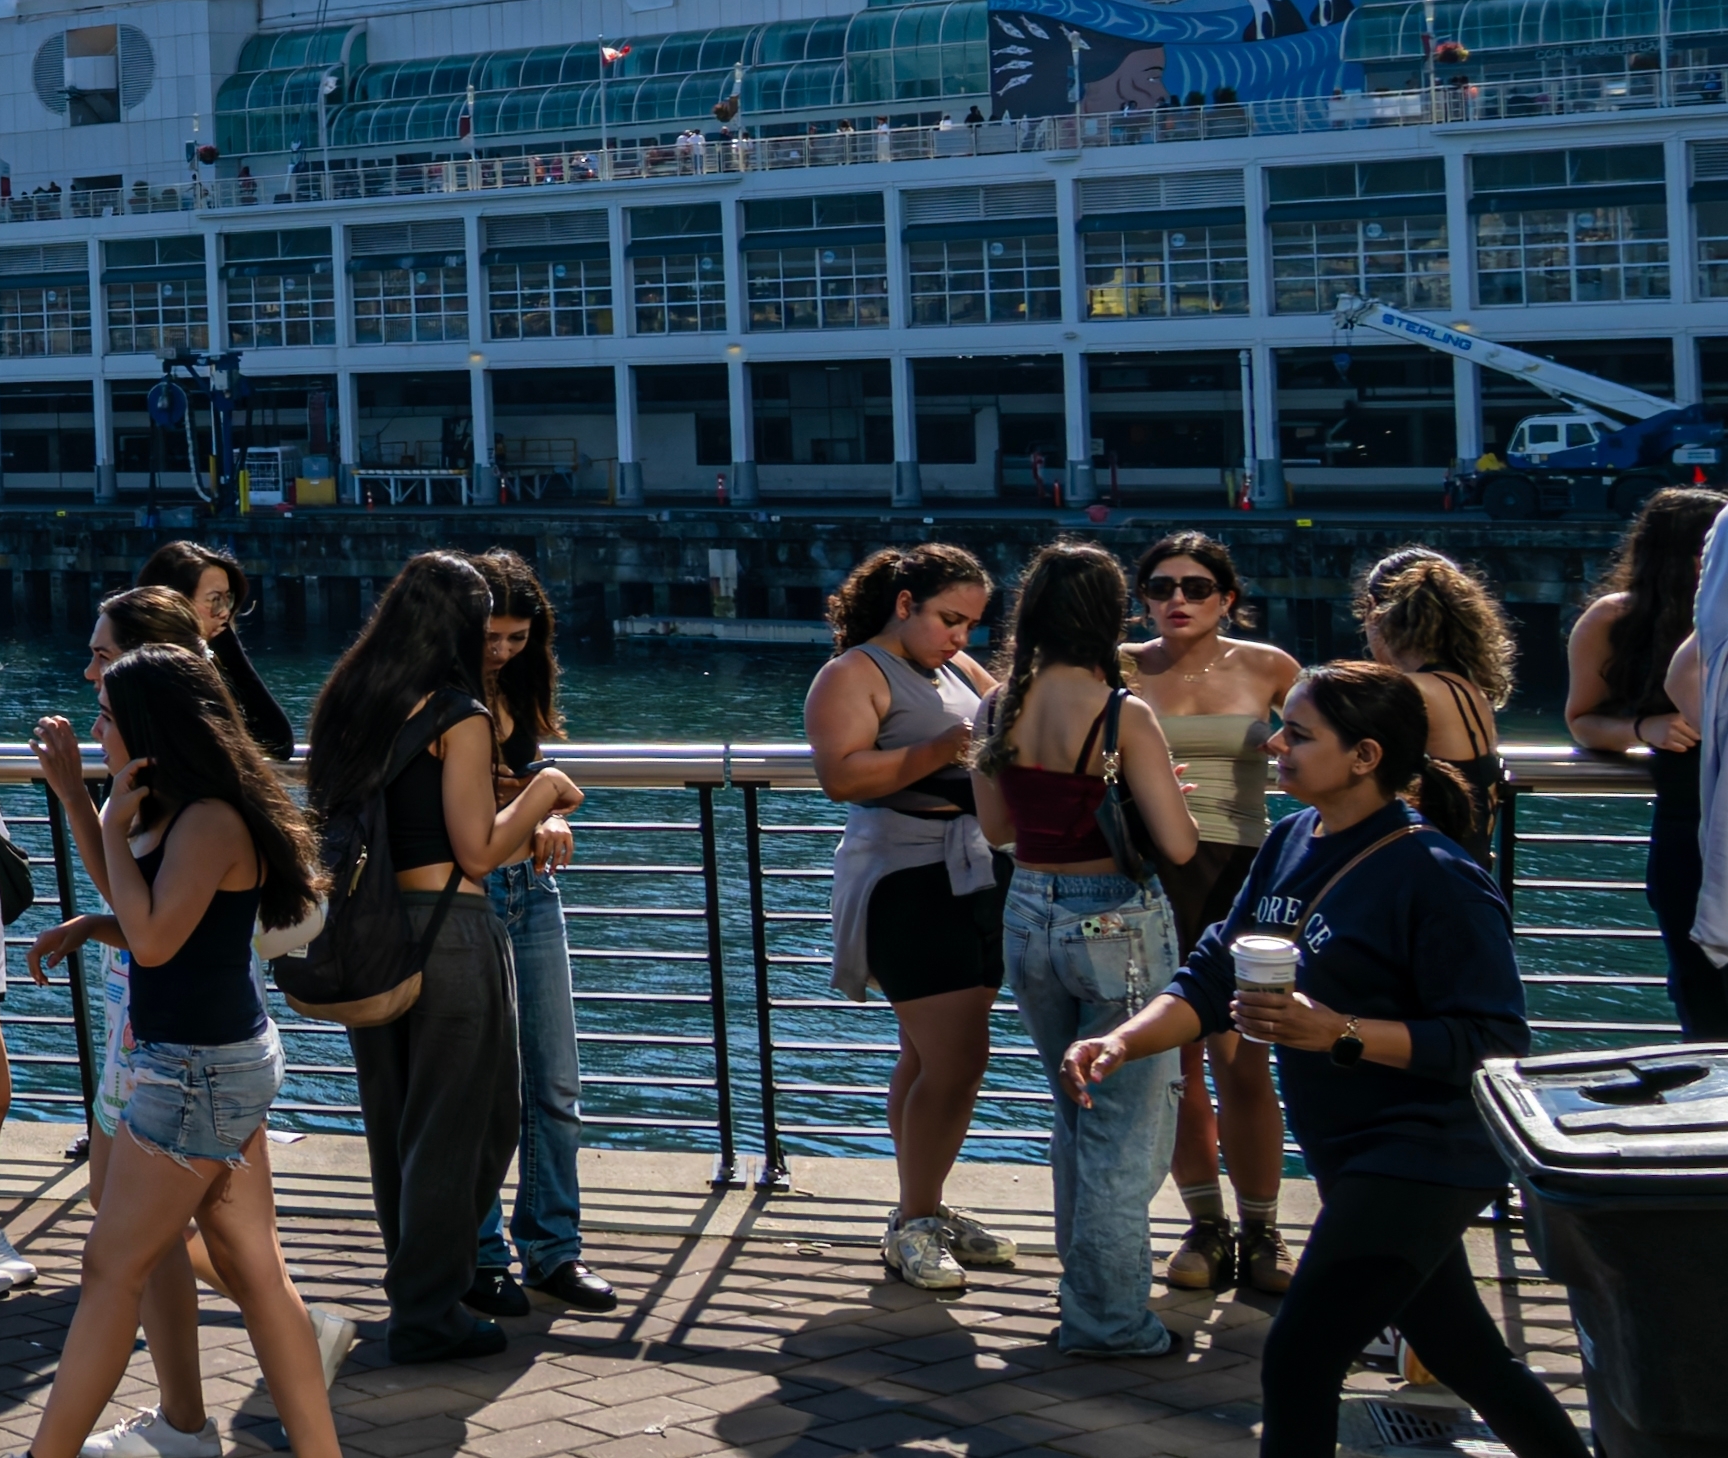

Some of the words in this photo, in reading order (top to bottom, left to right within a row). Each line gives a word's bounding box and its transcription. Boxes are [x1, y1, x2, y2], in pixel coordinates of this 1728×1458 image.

[1638, 39, 1673, 52] CAE
[1382, 313, 1472, 350] STERLING
[1250, 895, 1333, 955] ORECE
